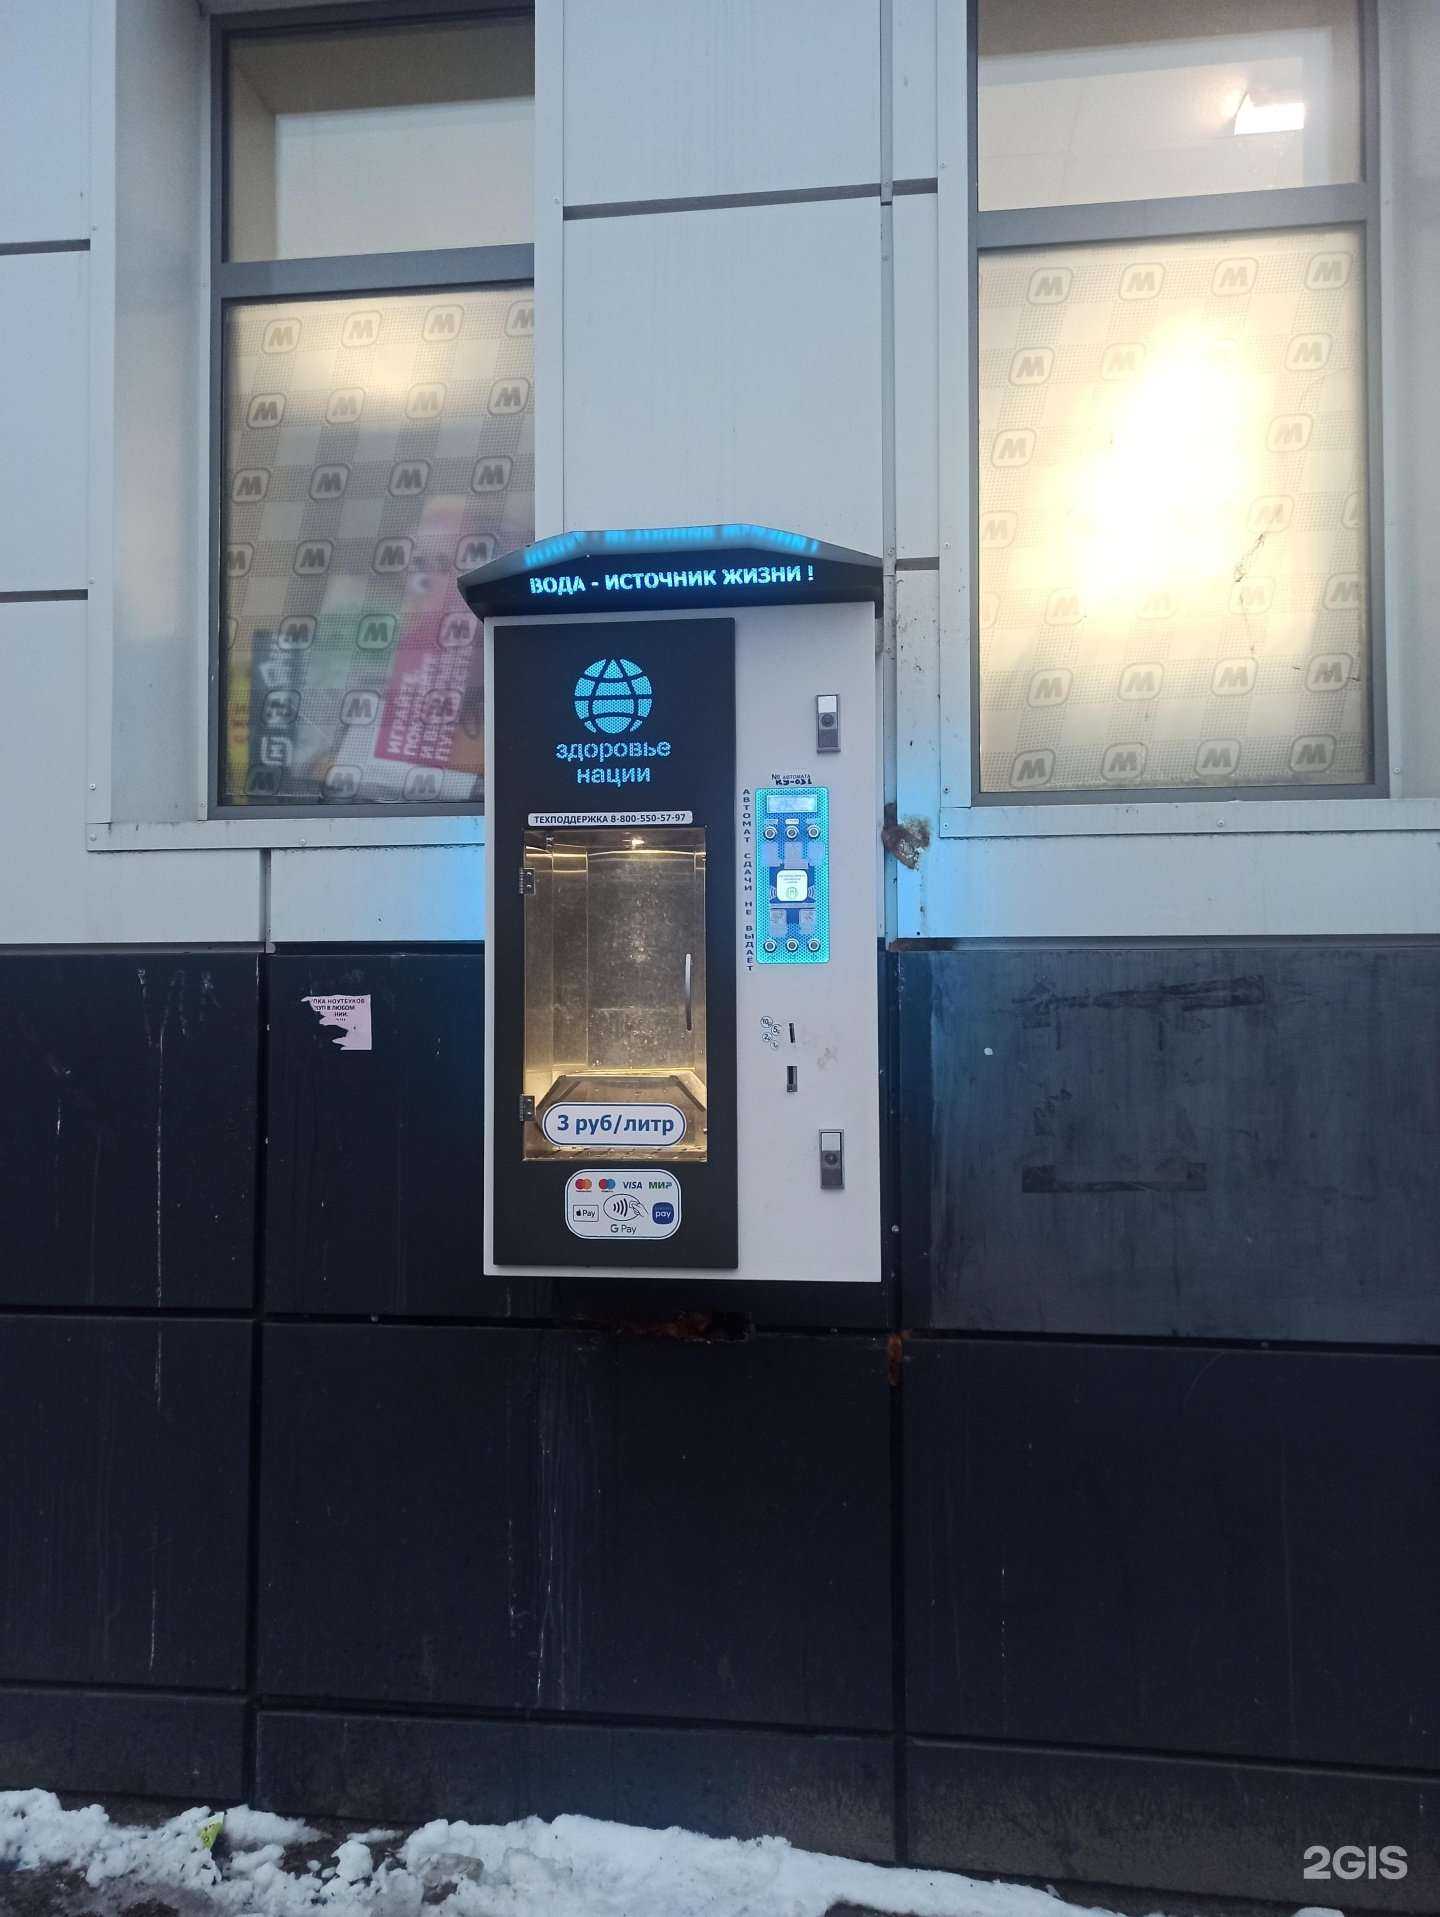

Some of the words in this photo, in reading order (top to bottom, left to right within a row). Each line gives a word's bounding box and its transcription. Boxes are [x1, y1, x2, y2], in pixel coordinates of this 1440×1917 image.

[530, 575, 586, 595] ВОДА
[605, 570, 717, 590] ИСТОЧНИК
[722, 565, 801, 585] ЖИЗНИ
[555, 741, 672, 763] здоровье
[577, 767, 651, 788] нации
[534, 815, 609, 825] ТЕХПОДДЕРЖКА
[610, 813, 686, 824] 8-800-550-57-97
[557, 1114, 569, 1131] 3
[575, 1114, 674, 1136] руб/литр
[623, 1181, 643, 1189] VISA
[648, 1181, 673, 1189] МИР
[582, 1209, 596, 1218] Pay
[655, 1210, 671, 1219] pay
[621, 1224, 637, 1235] Pay
